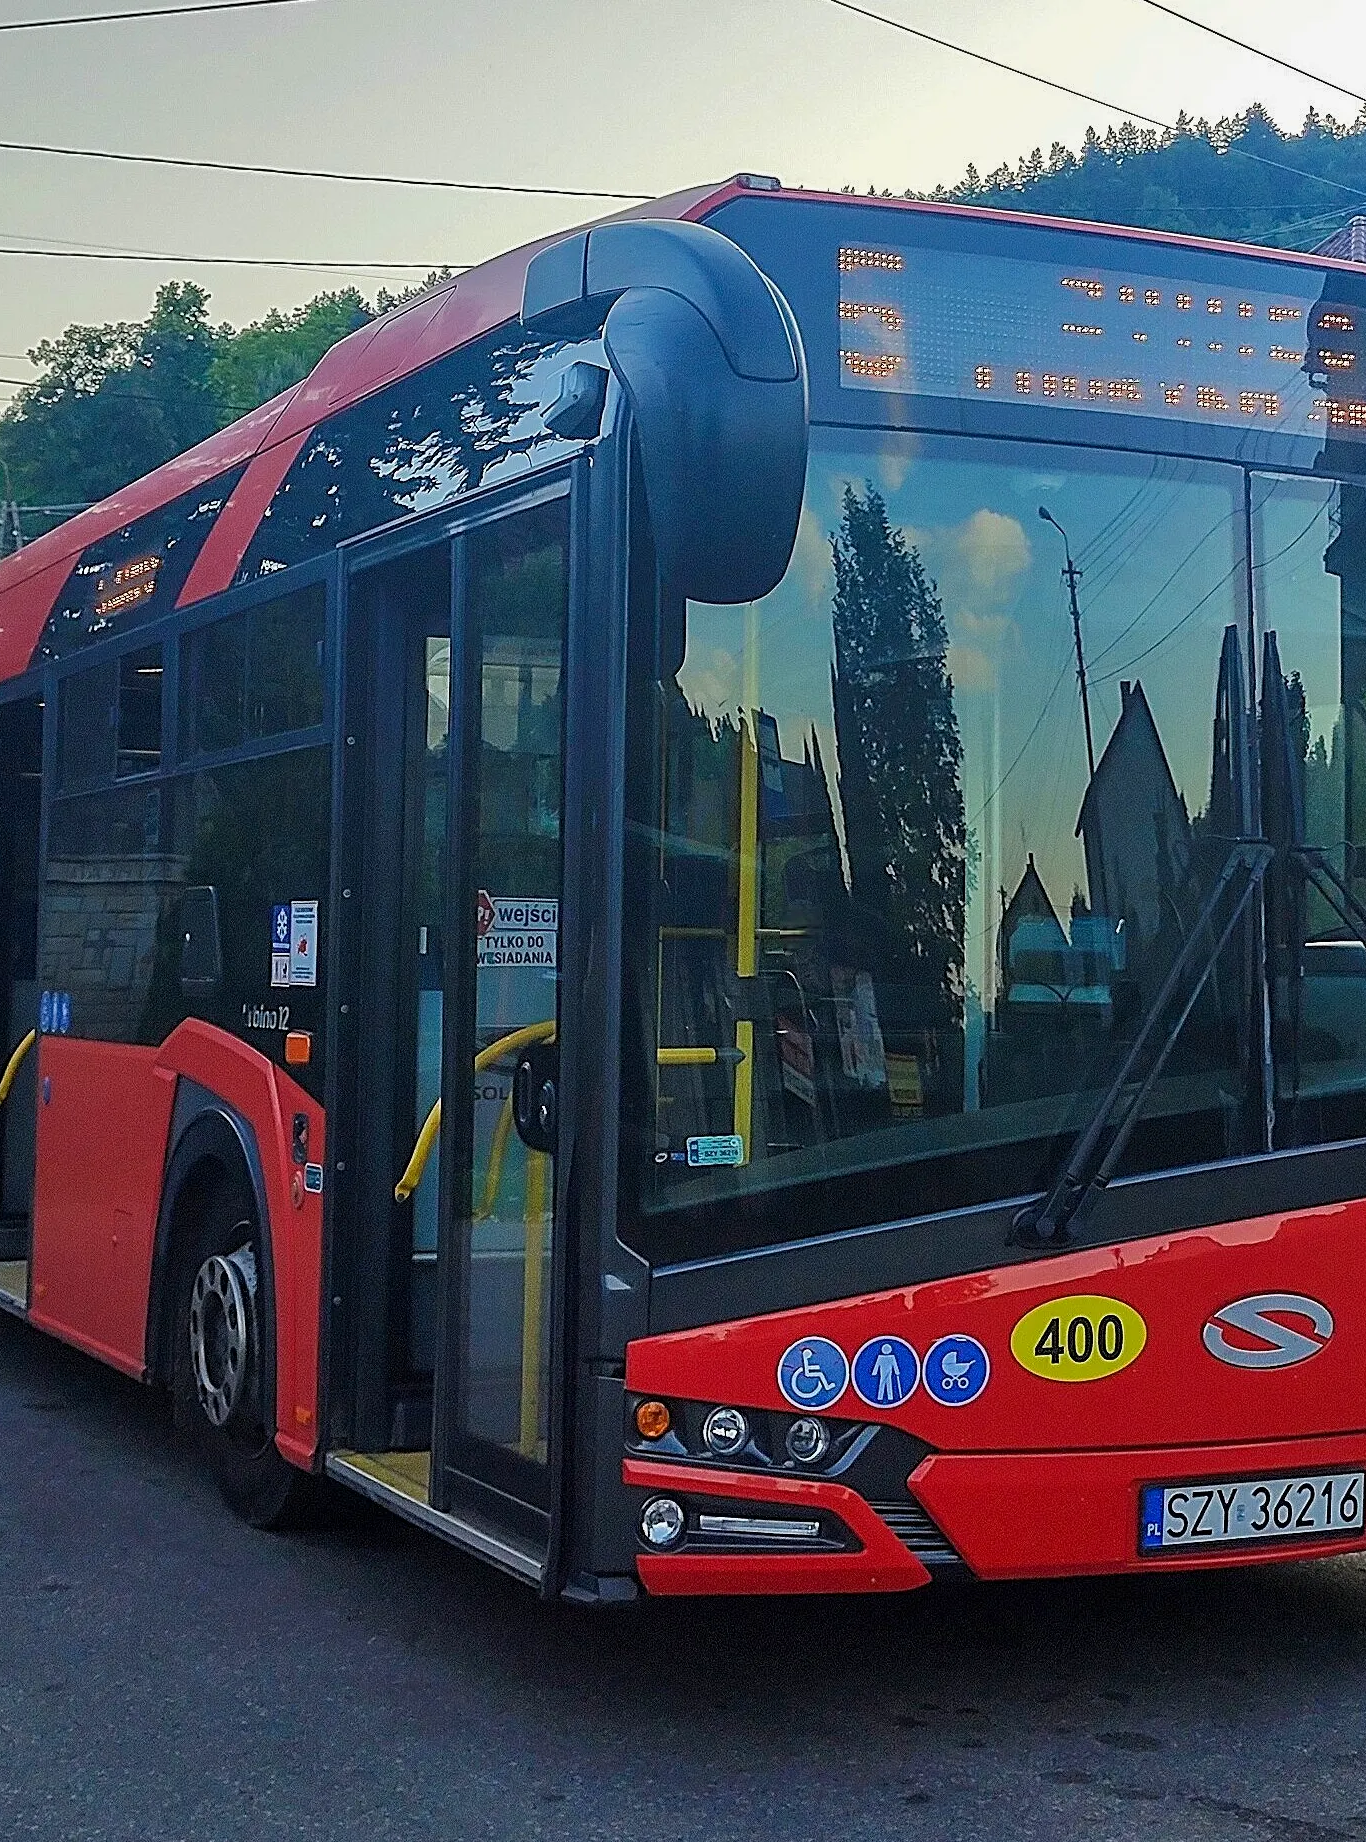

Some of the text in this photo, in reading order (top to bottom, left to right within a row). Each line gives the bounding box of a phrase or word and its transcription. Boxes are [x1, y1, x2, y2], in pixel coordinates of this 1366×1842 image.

[485, 935, 544, 949] TYLKO DO
[1034, 1314, 1124, 1365] 400
[1147, 1477, 1359, 1539] PL SZY 36216
